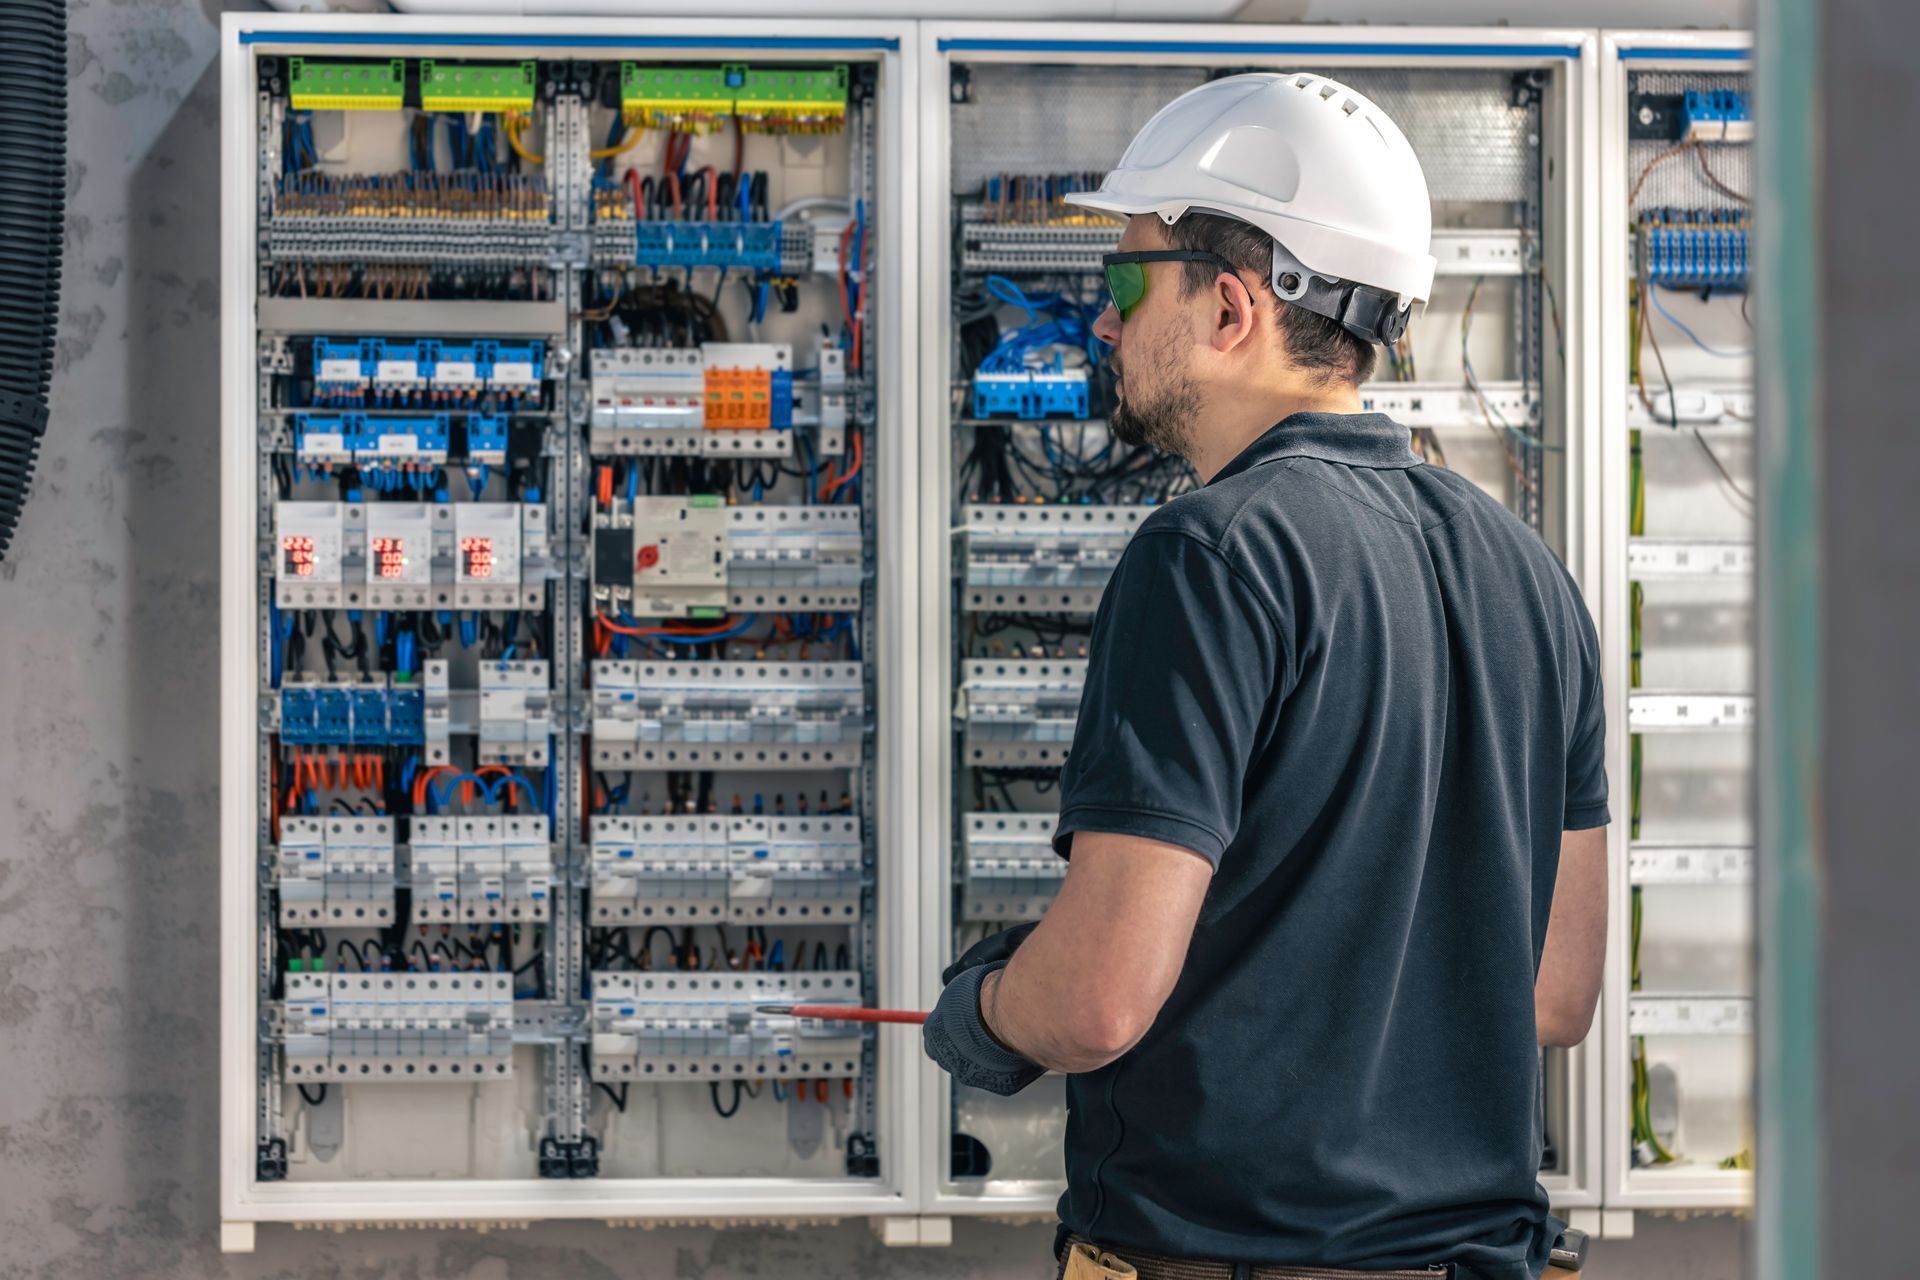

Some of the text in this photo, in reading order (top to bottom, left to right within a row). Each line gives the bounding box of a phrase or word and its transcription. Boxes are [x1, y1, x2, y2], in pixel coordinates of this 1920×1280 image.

[284, 537, 313, 550] 222
[372, 538, 402, 551] 231
[461, 538, 491, 551] 224
